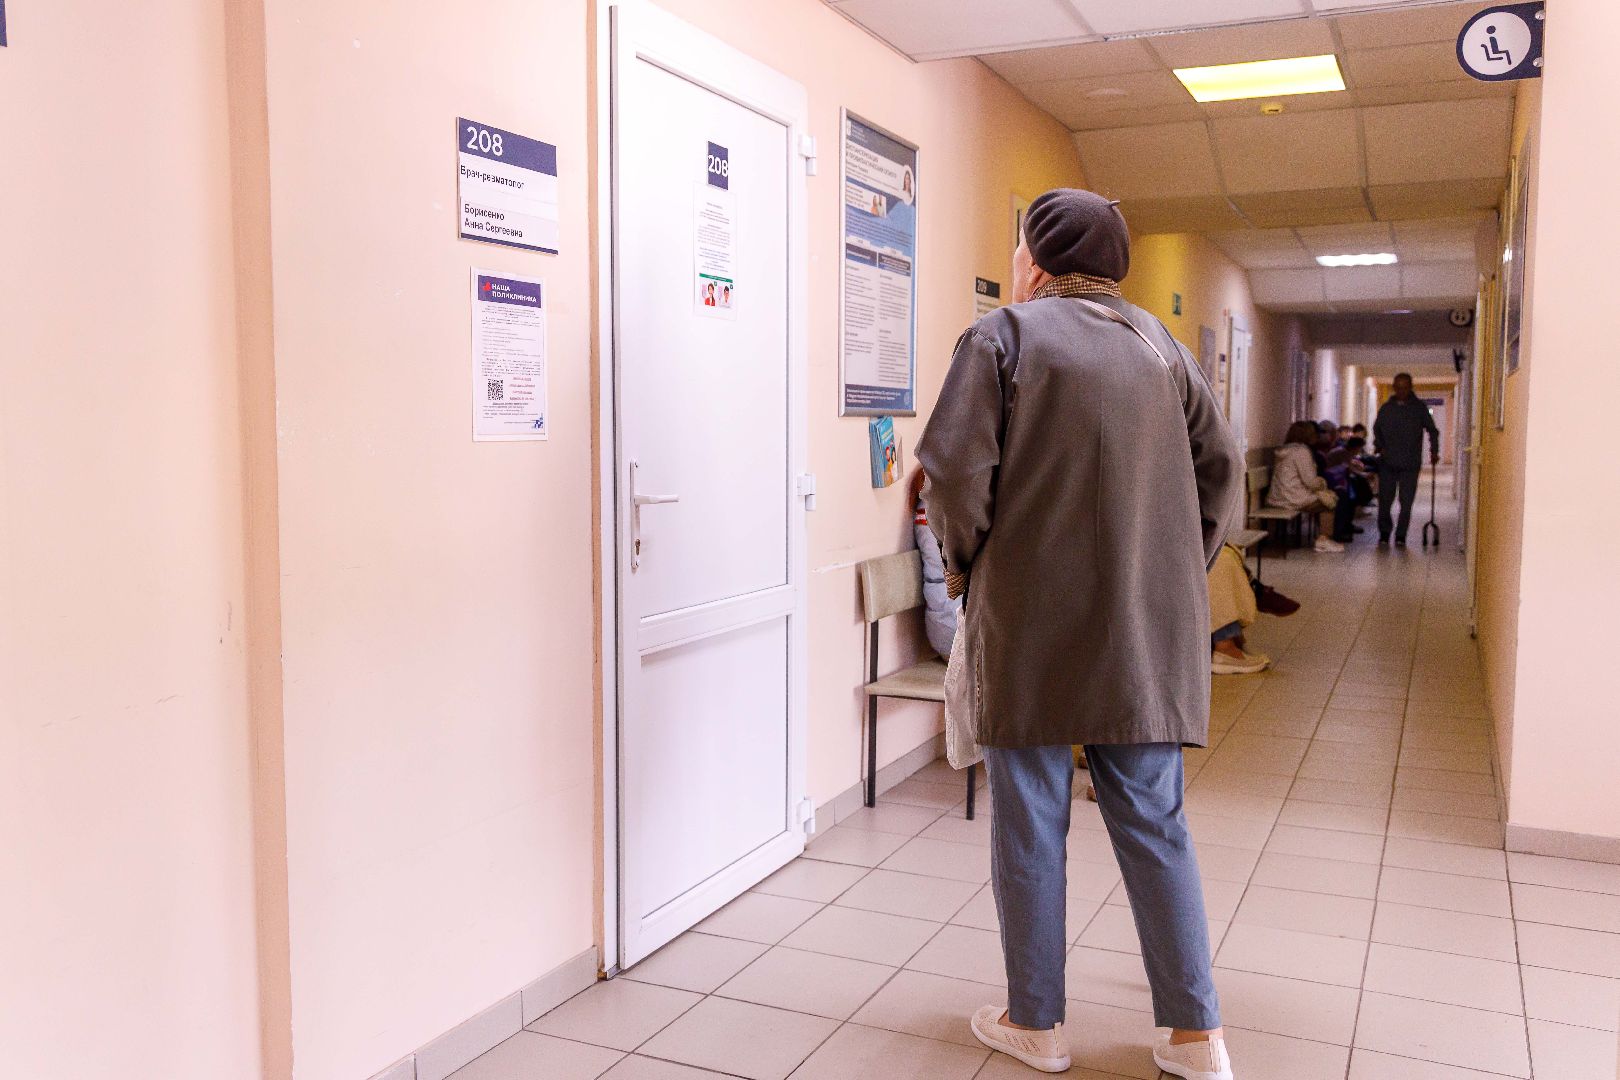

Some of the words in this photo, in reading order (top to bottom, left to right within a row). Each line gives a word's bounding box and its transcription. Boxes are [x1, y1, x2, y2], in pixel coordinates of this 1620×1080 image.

[467, 126, 503, 157] 208
[708, 154, 729, 178] 208
[464, 203, 505, 221] Борисенко
[464, 217, 484, 230] Анна
[485, 221, 523, 238] Сергеевна
[491, 283, 511, 292] НАША
[492, 291, 537, 303] ПОЛИКЛИНИКА
